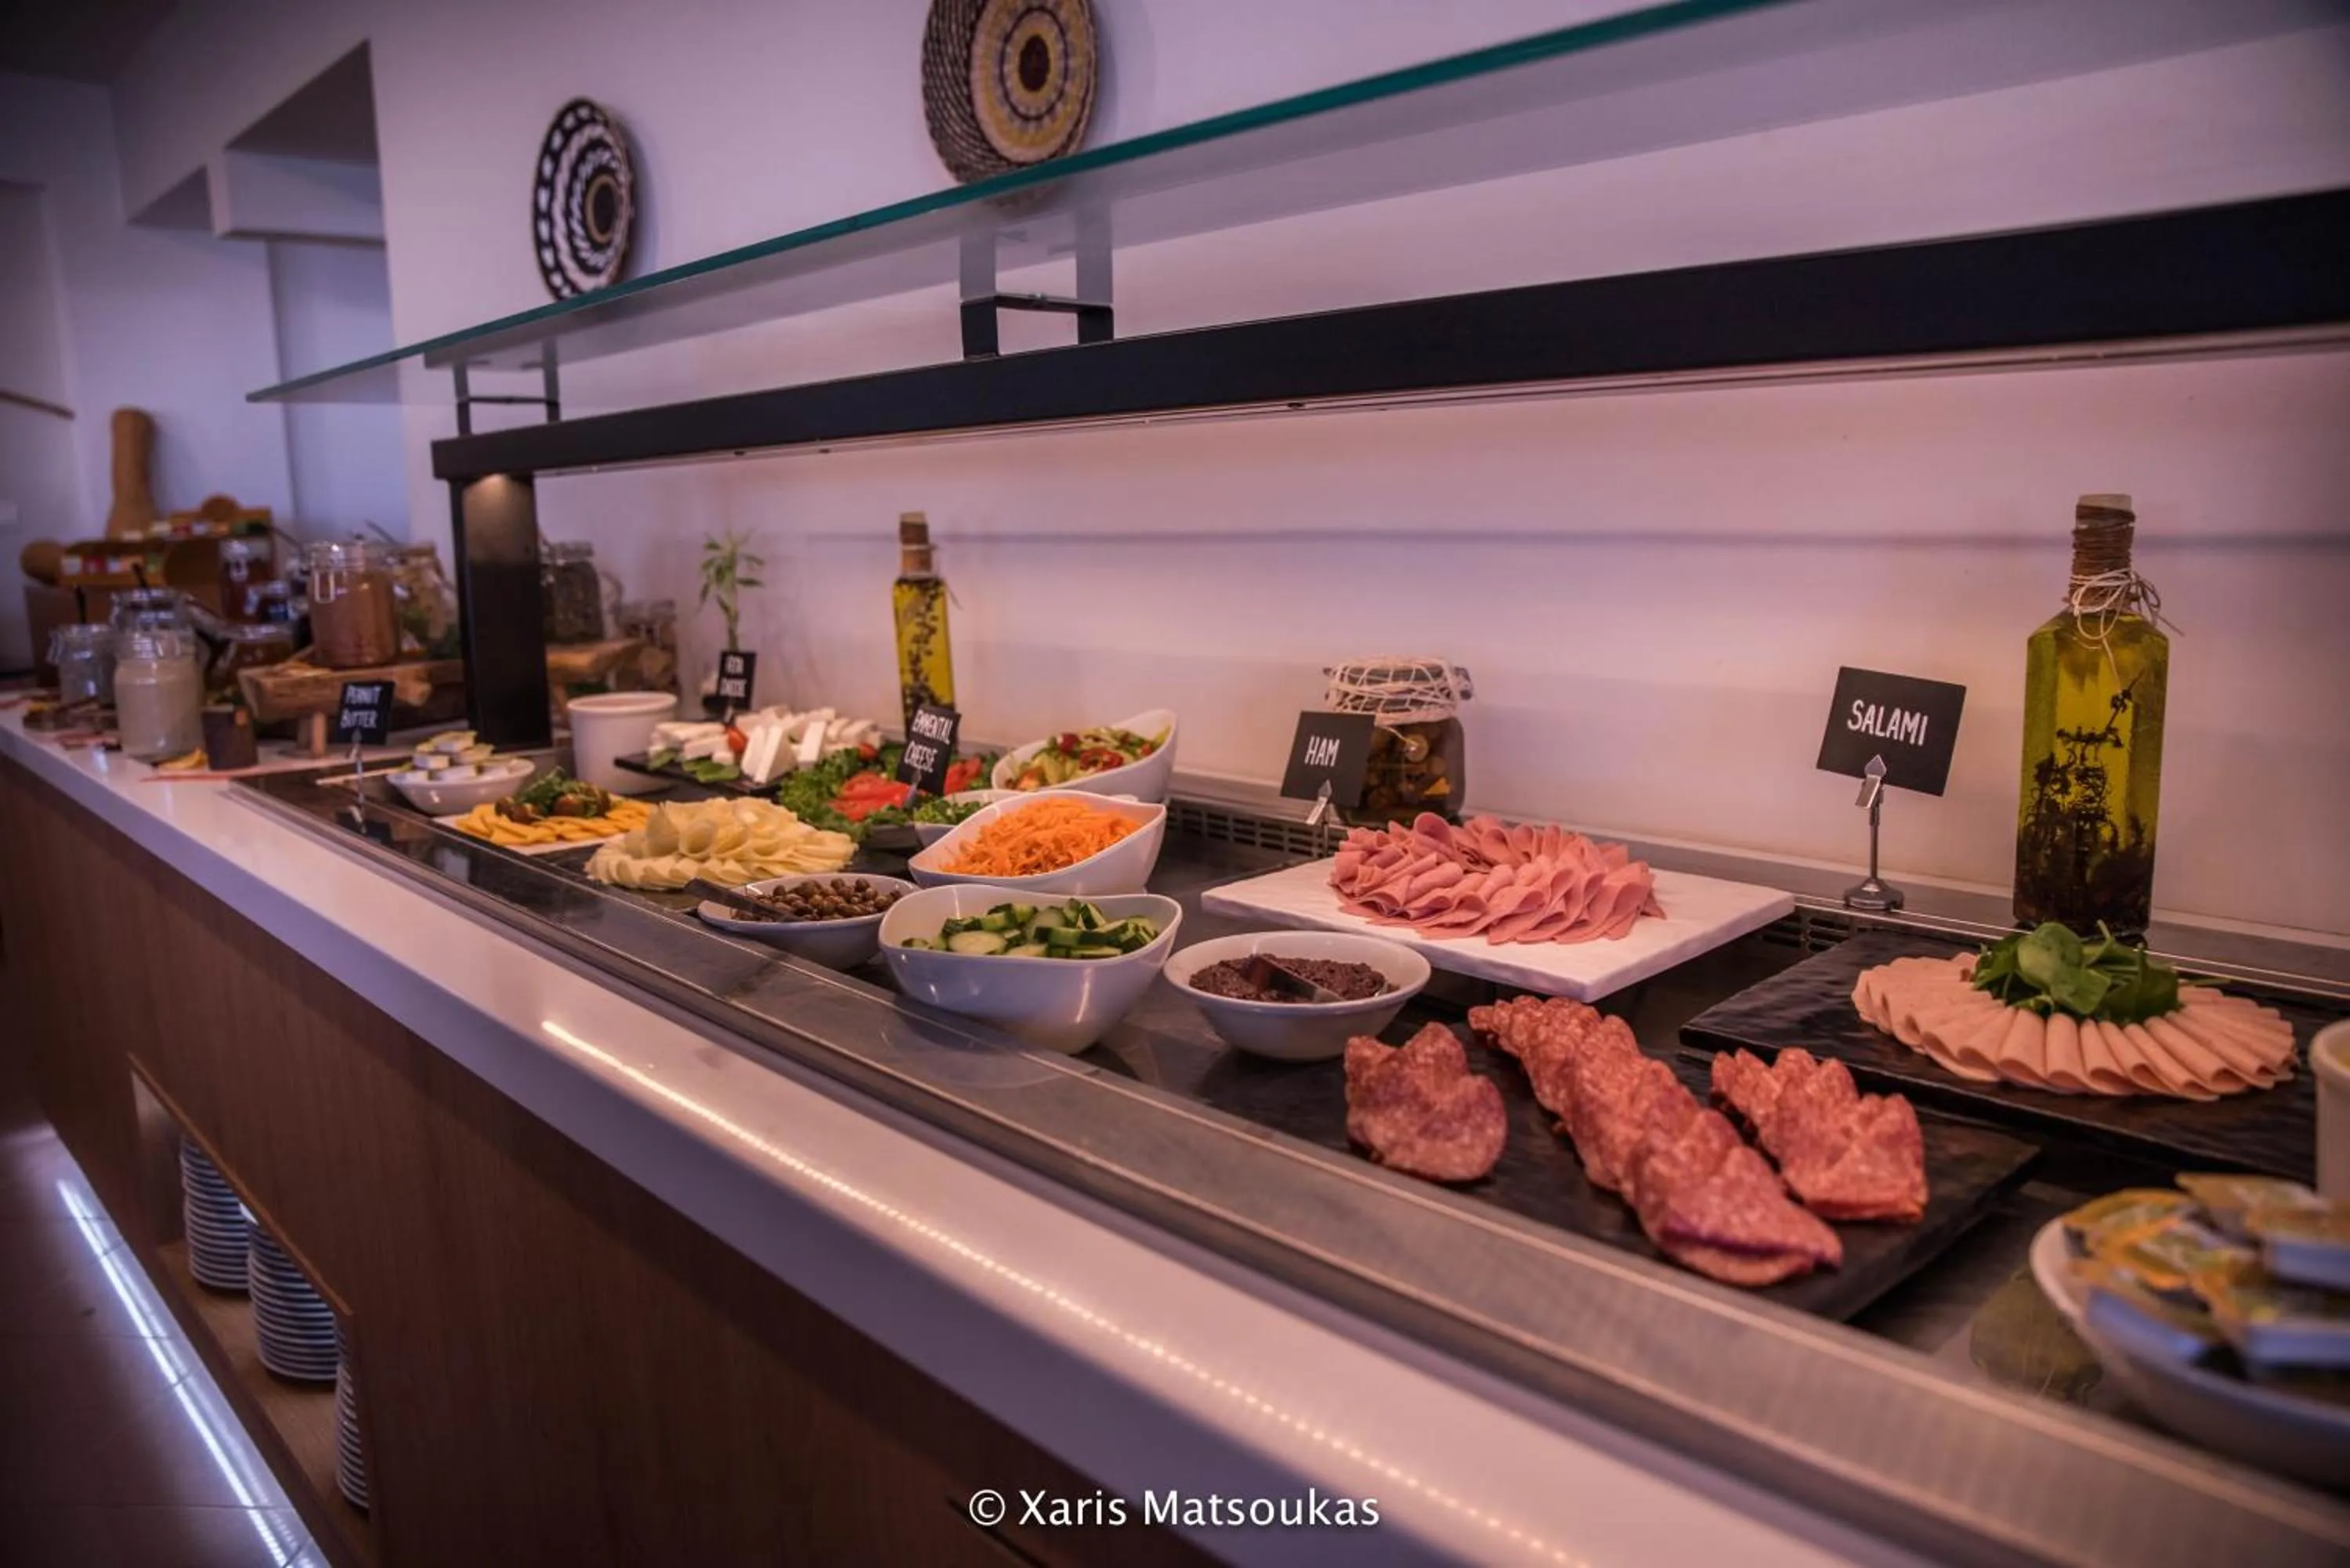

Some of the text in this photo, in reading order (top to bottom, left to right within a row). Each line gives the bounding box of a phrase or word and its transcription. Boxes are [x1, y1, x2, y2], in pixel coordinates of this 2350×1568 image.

[339, 708, 378, 728] BUTTER
[912, 709, 954, 745] EMMENTAL
[1847, 699, 1929, 746] SALAMI
[904, 740, 938, 773] CHEESE
[1303, 734, 1341, 768] HAM
